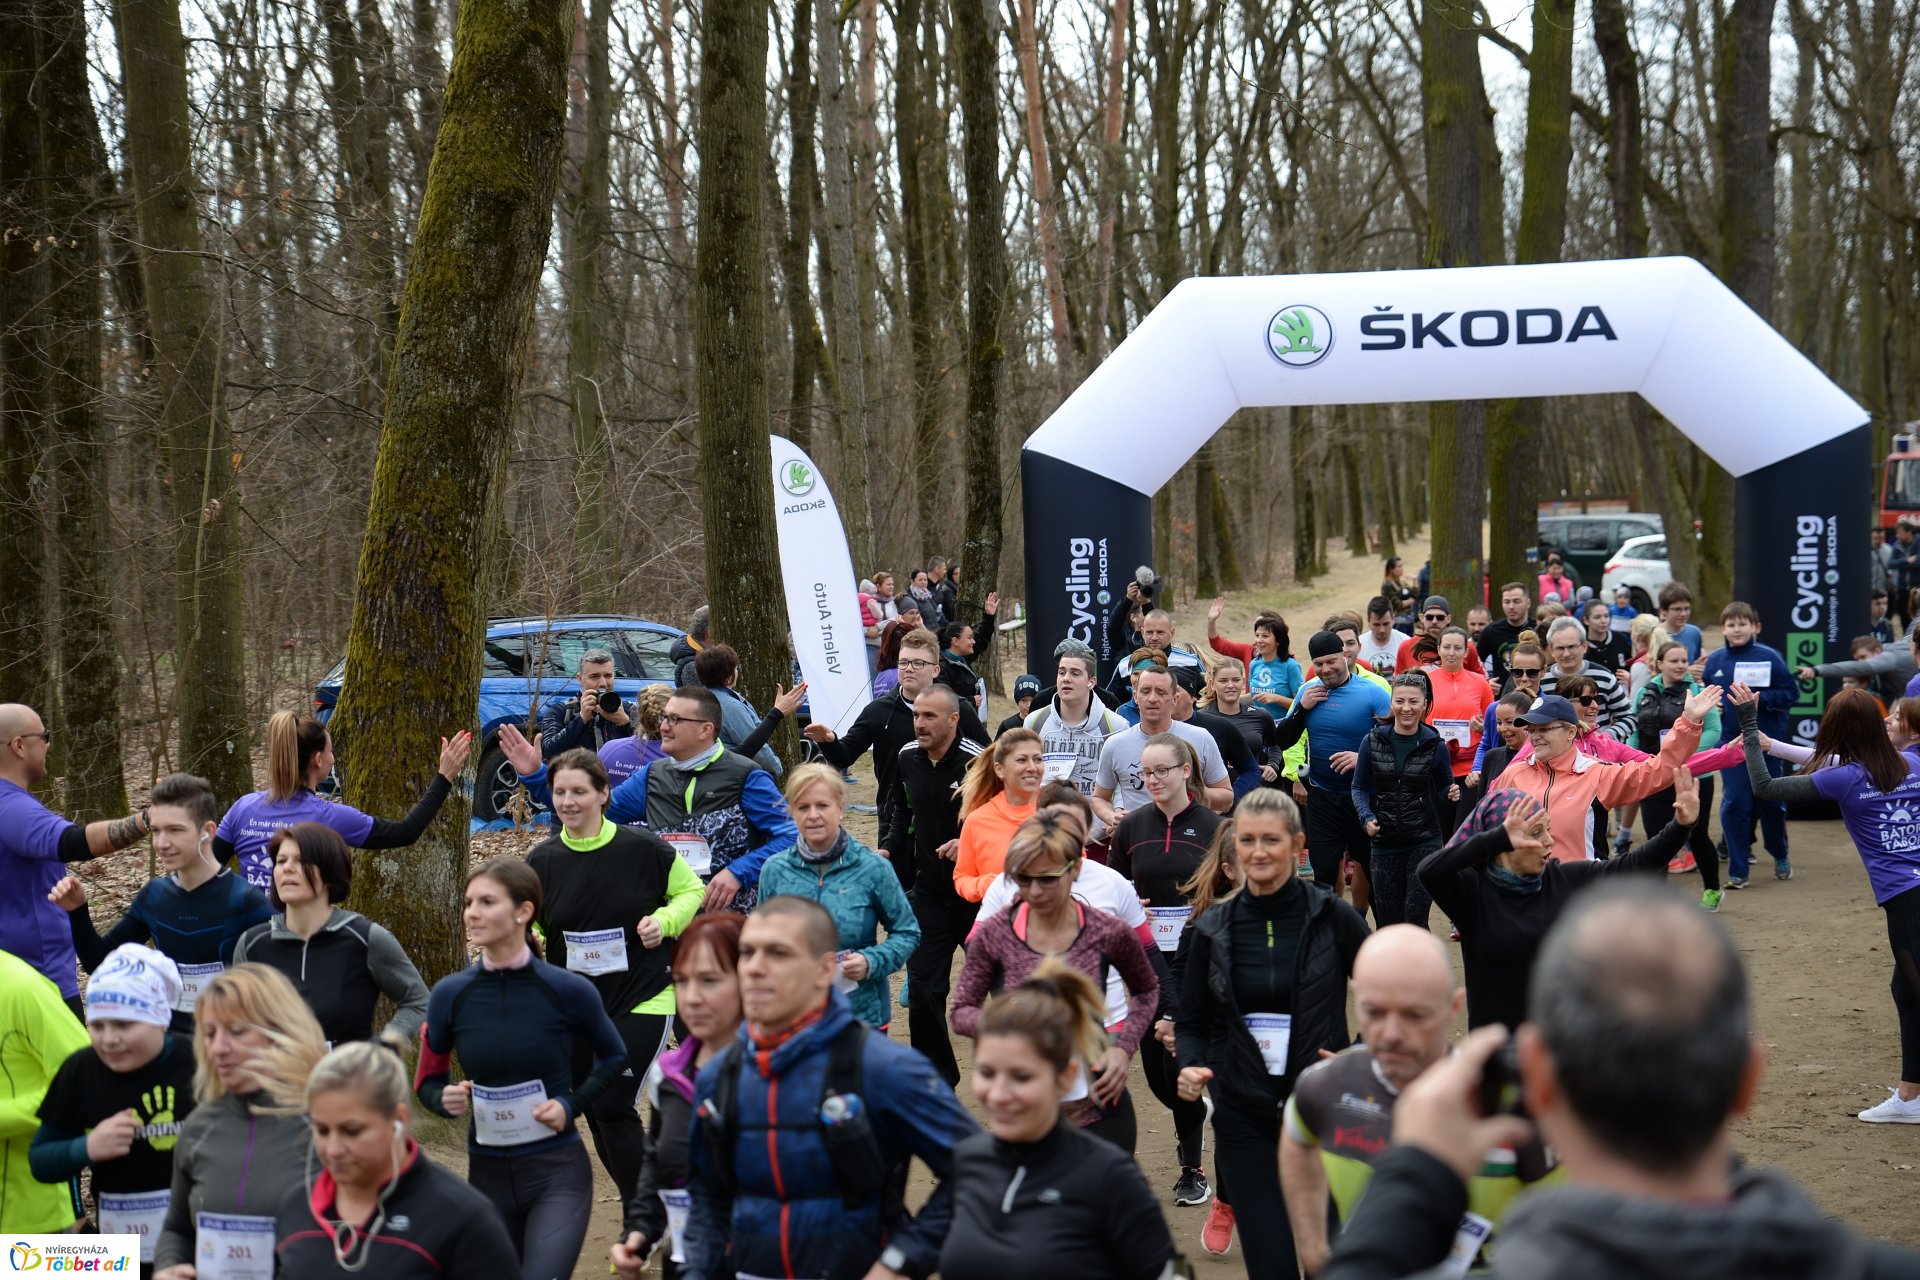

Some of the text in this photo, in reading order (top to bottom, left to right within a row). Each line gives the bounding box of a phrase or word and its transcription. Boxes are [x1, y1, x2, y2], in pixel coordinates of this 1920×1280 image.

[1360, 305, 1619, 350] ŠKODA
[1826, 515, 1838, 567] ŠKODA
[1098, 538, 1109, 587] ŠKODA
[1790, 515, 1824, 629] Cycling
[1065, 537, 1096, 646] Cycling
[247, 872, 273, 887] BÁT
[1158, 925, 1174, 933] 267
[583, 951, 601, 961] 346
[1256, 1039, 1271, 1050] 08
[494, 1110, 515, 1121] 265
[125, 1223, 149, 1234] 210
[227, 1245, 253, 1259] 201
